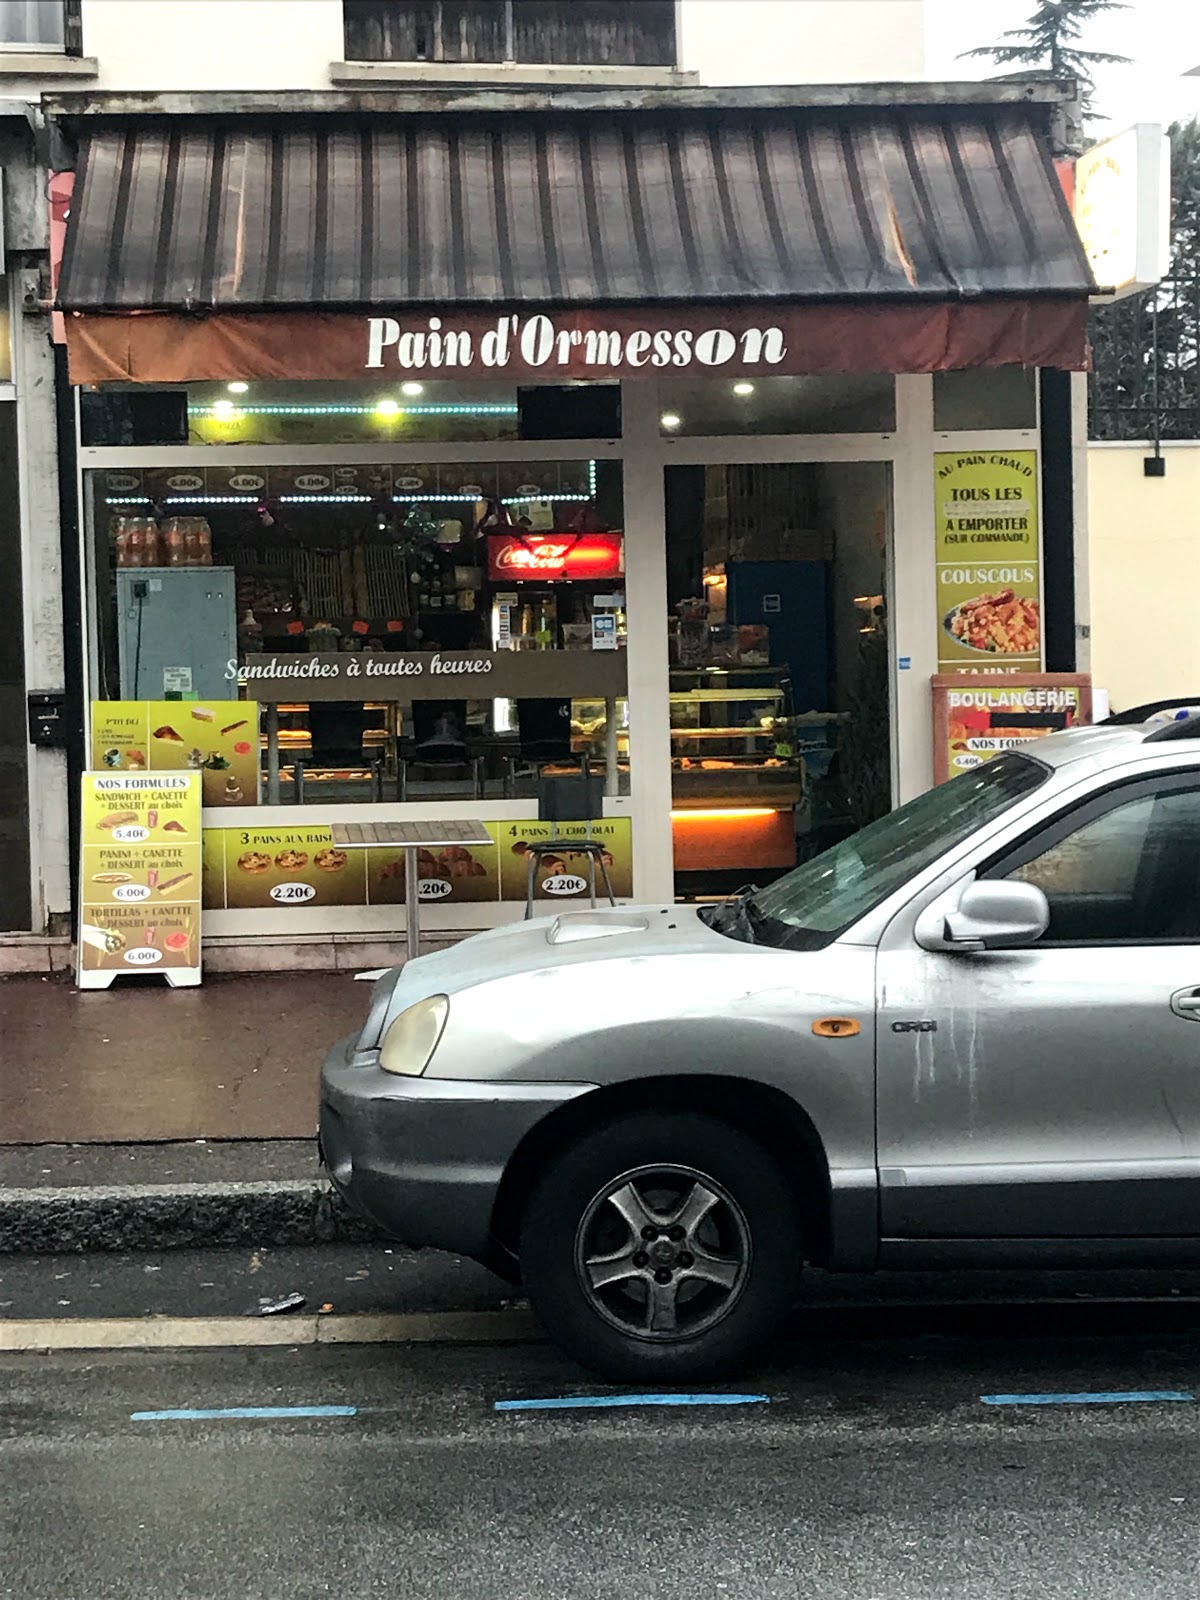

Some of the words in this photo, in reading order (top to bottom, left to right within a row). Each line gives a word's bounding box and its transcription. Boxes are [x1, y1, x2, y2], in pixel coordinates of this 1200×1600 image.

[365, 317, 474, 369] Pain
[481, 313, 788, 368] d'Ormesson
[938, 464, 954, 479] AU
[957, 455, 986, 469] PAIN
[990, 455, 1033, 477] CHAUD
[951, 488, 991, 501] TOUS
[995, 487, 1023, 501] LES
[946, 519, 954, 531] A
[958, 517, 1028, 531] EMPORTER
[944, 534, 968, 544] (SUR
[971, 533, 1030, 544] COMMANDE)
[940, 567, 1035, 584] COUSCOUS
[224, 657, 340, 680] Sandwiches
[346, 658, 361, 676] à
[365, 658, 424, 677] toutes
[430, 653, 492, 675] heures
[949, 690, 1077, 707] BOULANGERIE
[971, 739, 996, 749] NOS
[97, 779, 121, 789] NOS
[125, 778, 186, 789] FORMULES
[95, 792, 141, 802] SANDWICH
[151, 791, 189, 801] CANETTE
[107, 801, 145, 810] DESSERT
[161, 801, 183, 809] choix
[115, 829, 147, 839] 5.40€
[508, 824, 518, 836] 4
[521, 827, 549, 836] PAINS
[240, 832, 250, 845] 3
[253, 835, 282, 844] PAINS
[285, 834, 304, 843] AUX
[307, 834, 332, 843] RAISI
[99, 850, 132, 859] PANINI
[143, 848, 183, 857] CANETTE
[107, 860, 145, 869] DESSERT
[161, 860, 183, 868] choix
[418, 883, 449, 894] .20€
[545, 878, 584, 891] 2.20€
[117, 888, 148, 897] 6.00€
[273, 887, 313, 898] 2.20€
[90, 908, 141, 917] TORTILLAS
[127, 951, 158, 961] 6.00€
